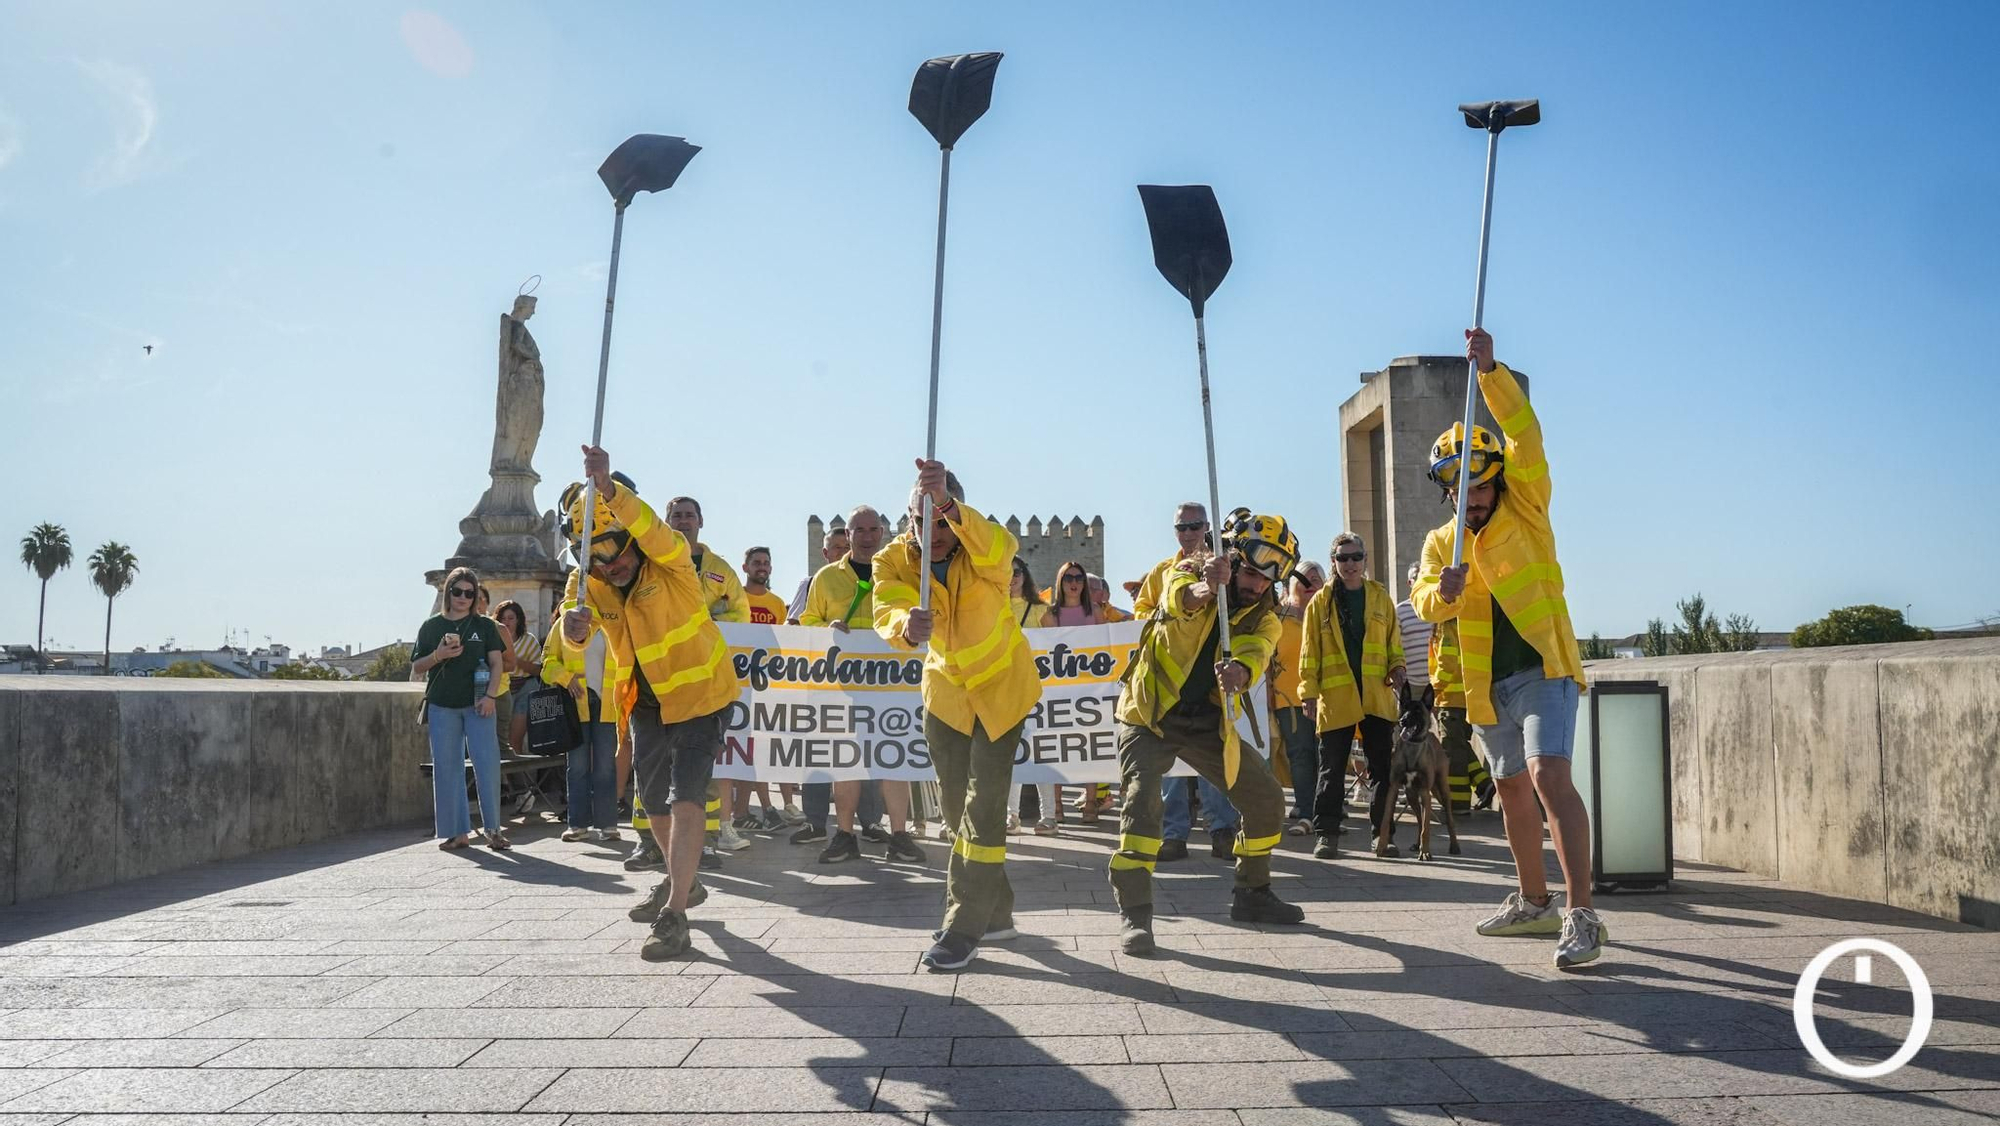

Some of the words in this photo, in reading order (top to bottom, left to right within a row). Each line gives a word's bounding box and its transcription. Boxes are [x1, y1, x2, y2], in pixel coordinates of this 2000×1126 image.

[602, 612, 619, 620] FOCA
[733, 646, 922, 691] efendamo
[1035, 643, 1115, 679] stro
[547, 704, 564, 718] LIFE
[727, 701, 925, 737] OMBER@
[1024, 695, 1120, 729] REST
[715, 736, 754, 766] IN
[769, 737, 932, 769] MEDIOS
